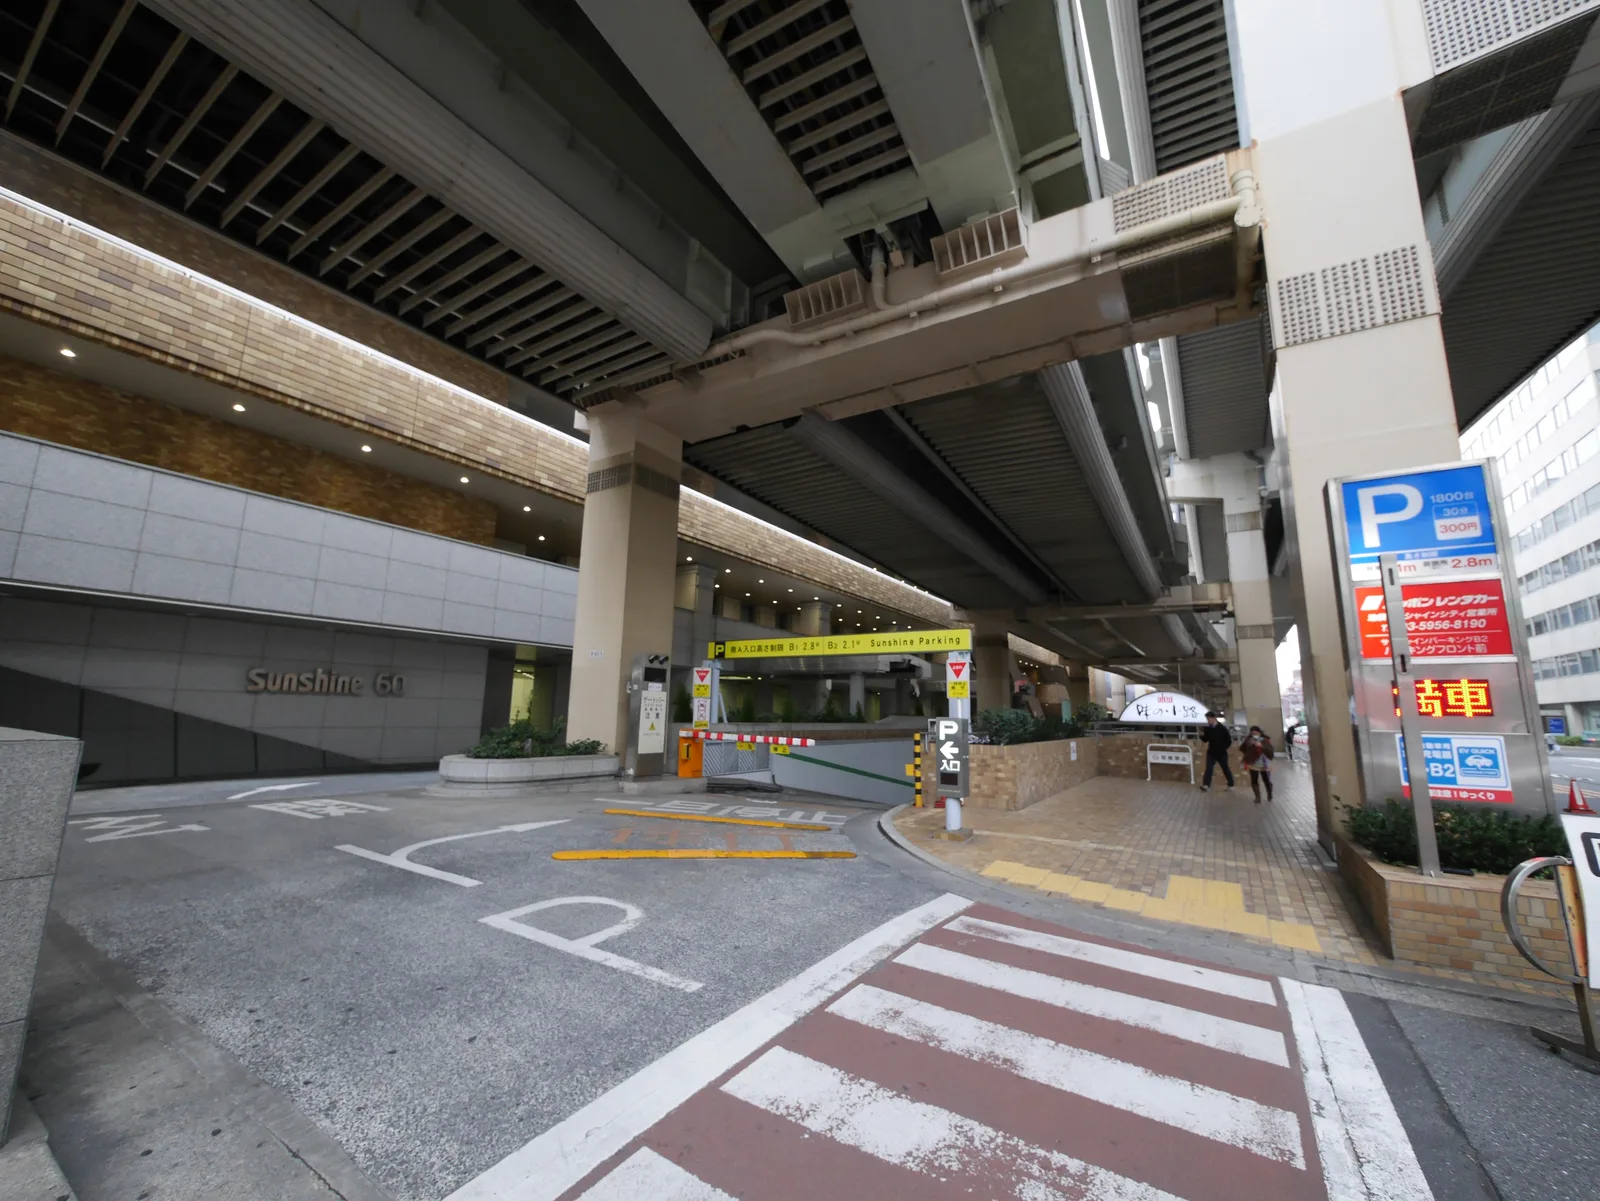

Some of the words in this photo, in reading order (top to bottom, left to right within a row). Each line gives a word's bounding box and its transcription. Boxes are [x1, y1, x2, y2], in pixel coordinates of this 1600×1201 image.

[1430, 491, 1474, 503] 1800台
[1357, 484, 1424, 548] P
[1442, 507, 1469, 517] 30分
[1440, 522, 1478, 534] 300円
[1451, 557, 1493, 569] 2.8m
[871, 639, 914, 647] Sunshine
[919, 636, 961, 646] Parking
[716, 645, 724, 655] P
[247, 668, 365, 696] Sunshine
[374, 672, 406, 698] 60
[939, 720, 959, 740] P
[940, 759, 961, 772] 入口
[477, 895, 704, 993] P
